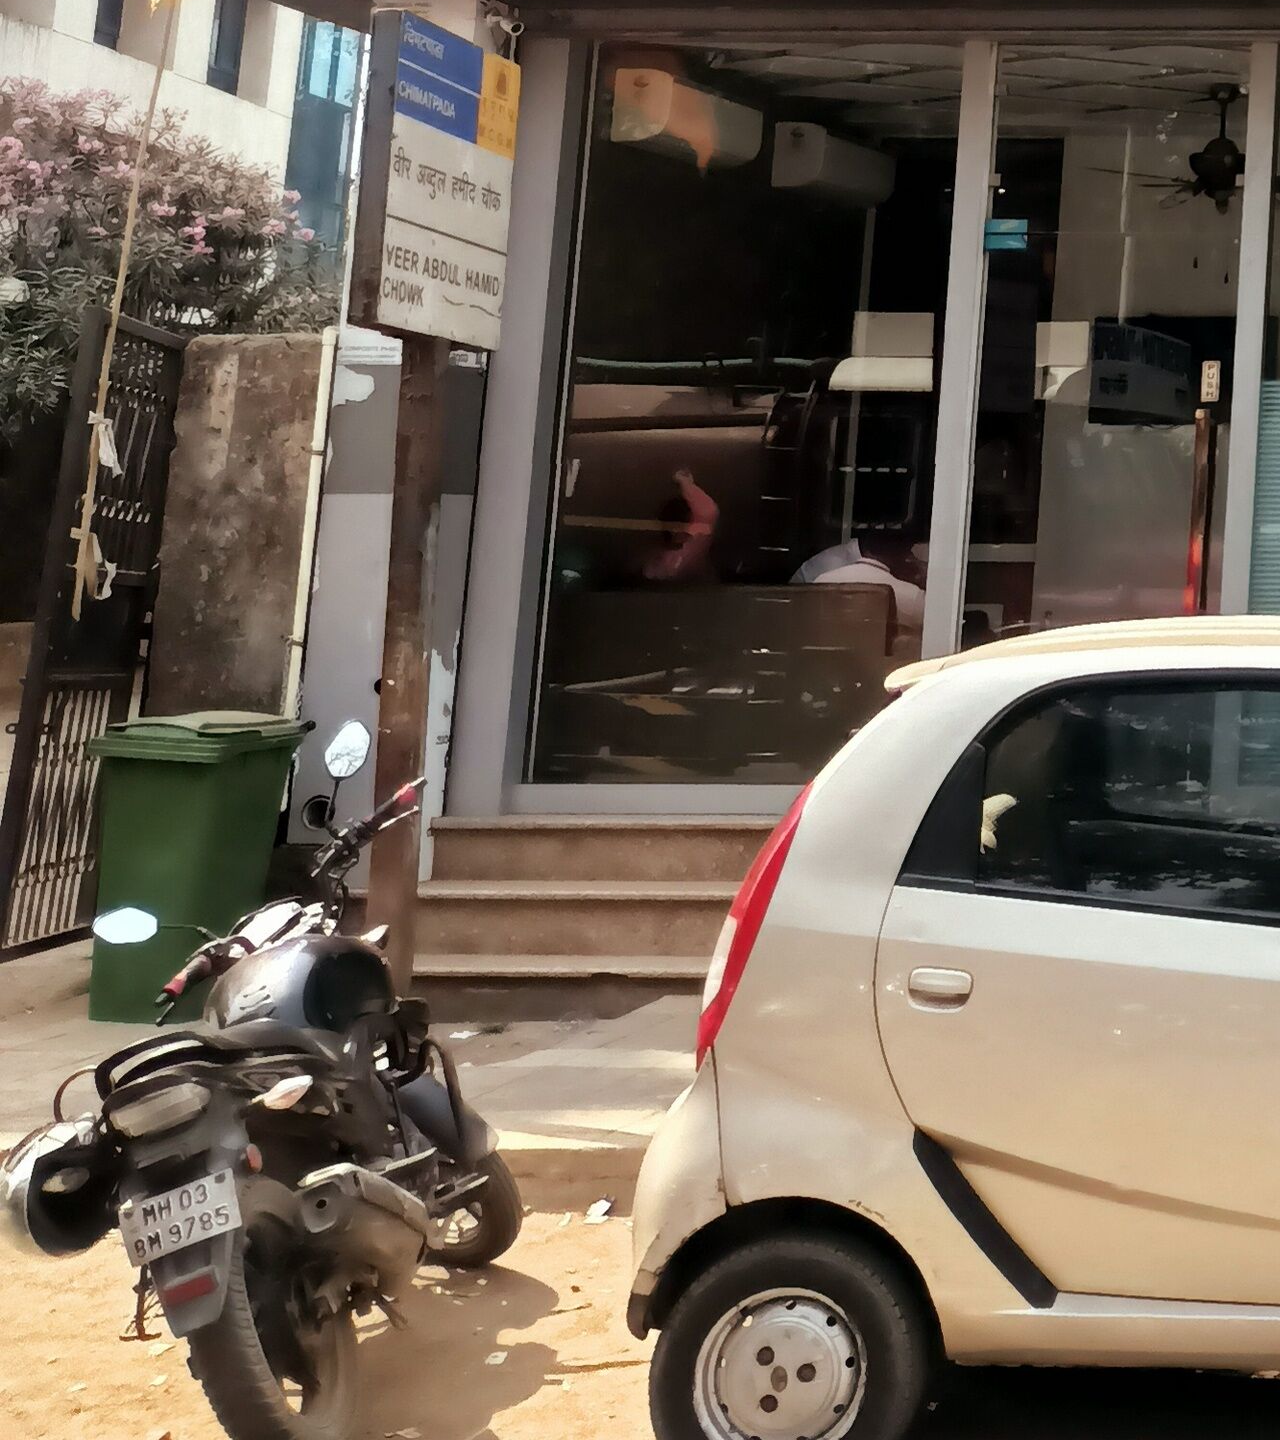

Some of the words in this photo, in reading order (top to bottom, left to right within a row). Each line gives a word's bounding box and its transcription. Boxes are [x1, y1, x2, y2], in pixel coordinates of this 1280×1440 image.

[398, 80, 456, 119] CHIMATPADA
[393, 146, 412, 180] वीर
[416, 164, 447, 200] अब्दुल
[451, 171, 477, 204] हमीद
[481, 181, 502, 212] चौक
[386, 244, 419, 274] VEER
[422, 256, 461, 287] ABDUL
[465, 269, 500, 297] HAMID
[383, 276, 425, 308] CHOWK
[142, 1197, 172, 1226] MH
[179, 1184, 208, 1210] 03
[168, 1205, 230, 1244] 9785
